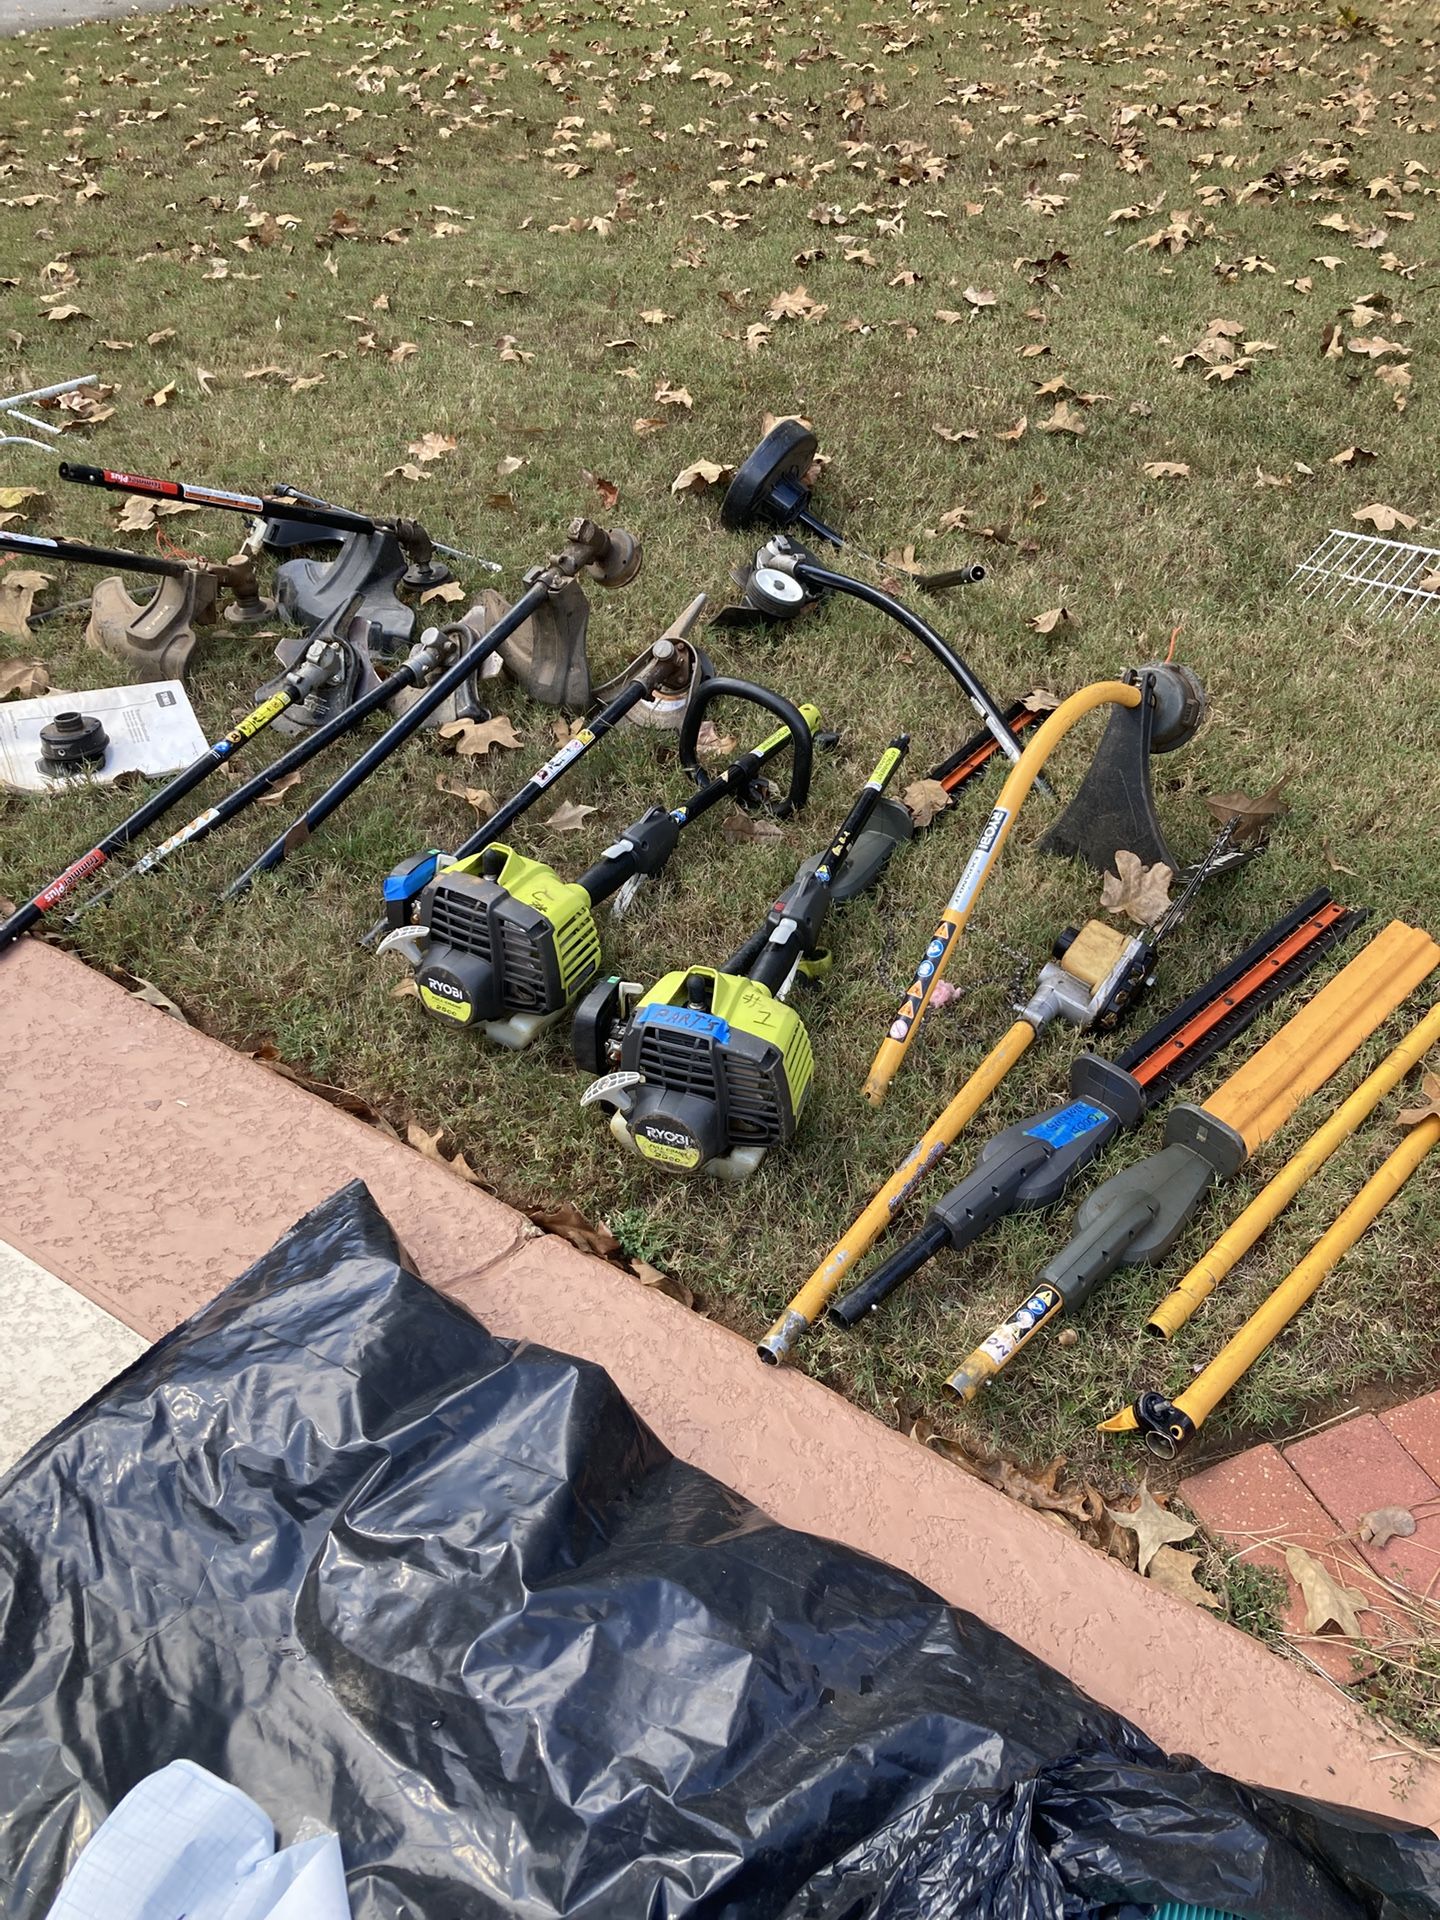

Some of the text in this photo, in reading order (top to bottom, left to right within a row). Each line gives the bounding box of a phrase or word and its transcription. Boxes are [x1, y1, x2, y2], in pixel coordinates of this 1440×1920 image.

[978, 811, 1005, 851] RYOBI
[44, 855, 99, 902] TrimmerPlus
[427, 977, 463, 1000] RYOBI
[645, 1125, 689, 1146] RYOBI
